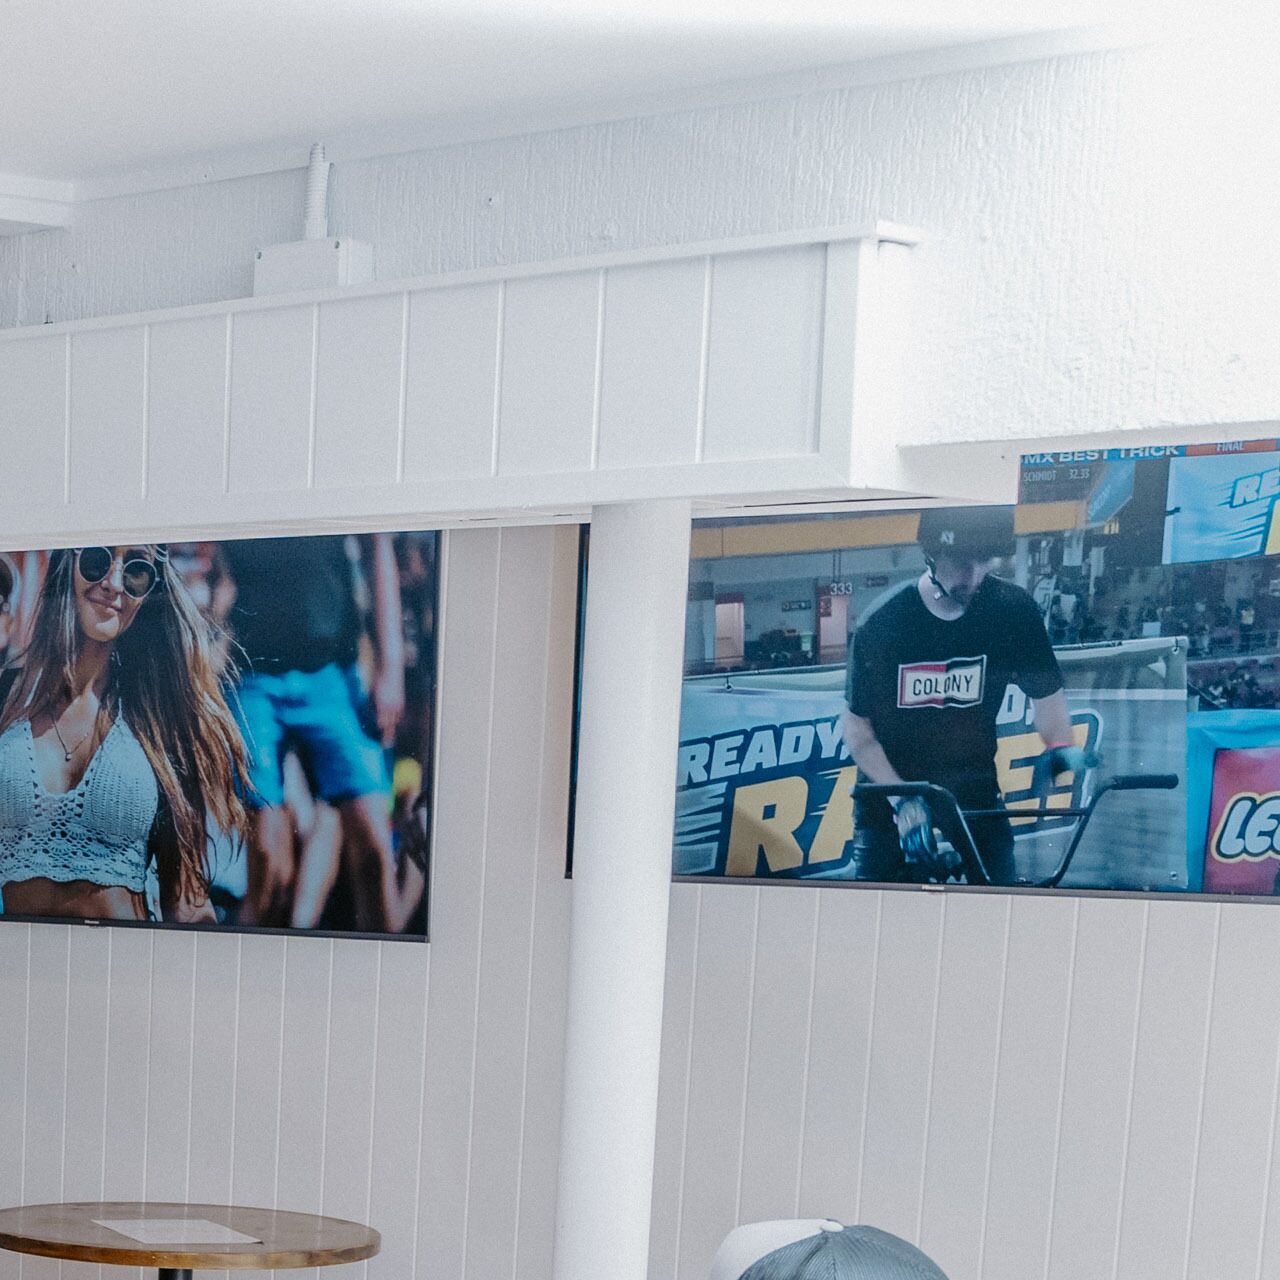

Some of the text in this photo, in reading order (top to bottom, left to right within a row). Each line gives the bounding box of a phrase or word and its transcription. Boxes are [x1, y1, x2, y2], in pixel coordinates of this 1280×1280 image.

[1216, 441, 1245, 452] FINAL
[1021, 453, 1055, 465] MX
[830, 583, 853, 596] 333
[911, 674, 974, 697] COLONY
